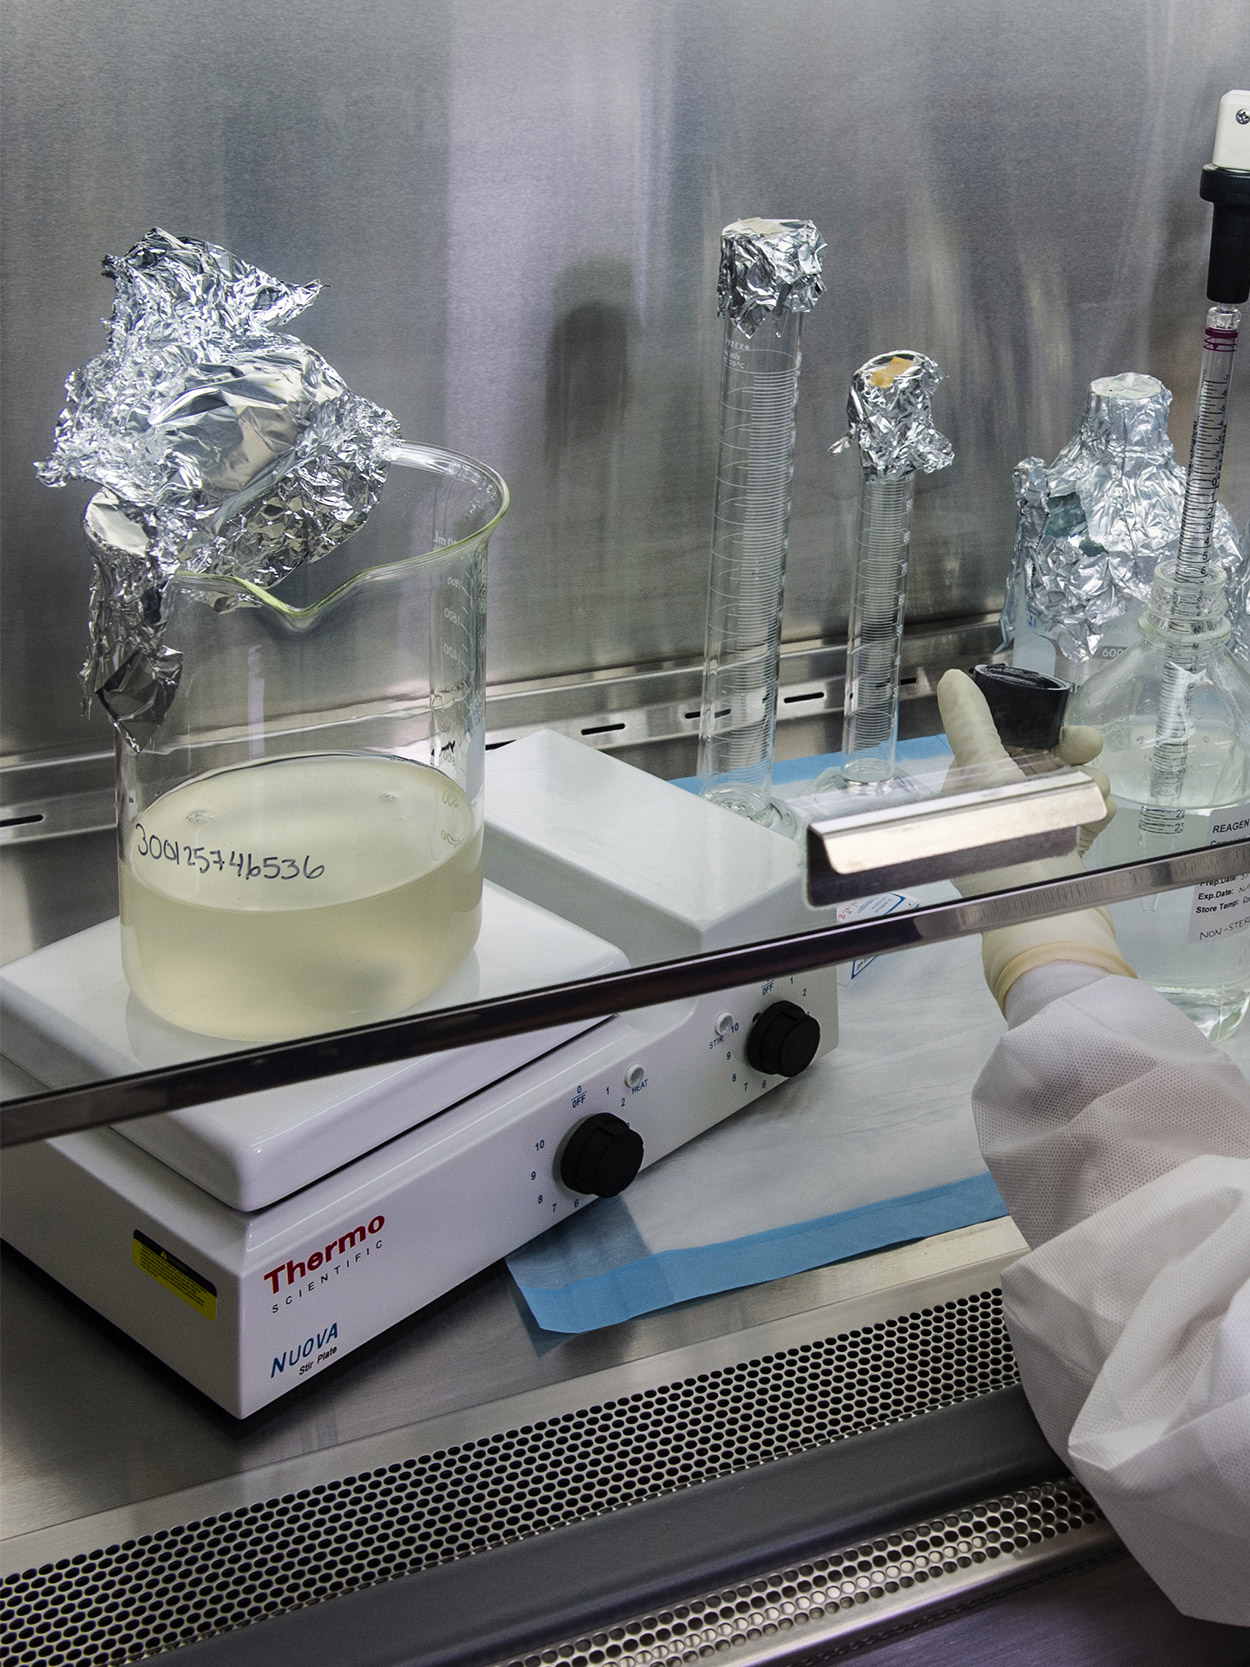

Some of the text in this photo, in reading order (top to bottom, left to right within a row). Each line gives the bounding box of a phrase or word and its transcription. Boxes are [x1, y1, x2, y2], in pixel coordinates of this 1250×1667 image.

[135, 823, 326, 881] 300125746536
[1197, 888, 1234, 901] Exp.Date:
[1195, 905, 1217, 915] Store
[1219, 899, 1239, 910] Temp:
[761, 982, 774, 995] OFF
[803, 988, 807, 997] 2
[731, 1022, 740, 1033] 10
[726, 1051, 732, 1061] 9
[605, 1086, 610, 1096] 1
[631, 1078, 649, 1095] HEAT
[571, 1094, 586, 1109] OFF
[620, 1097, 626, 1107] 2
[535, 1139, 545, 1151] 10
[530, 1170, 537, 1181] 9
[263, 1214, 386, 1295] Thermo
[271, 1240, 383, 1314] SCIENTIFIC
[270, 1322, 339, 1379] NUOVA
[299, 1346, 338, 1376] Stir Plate
